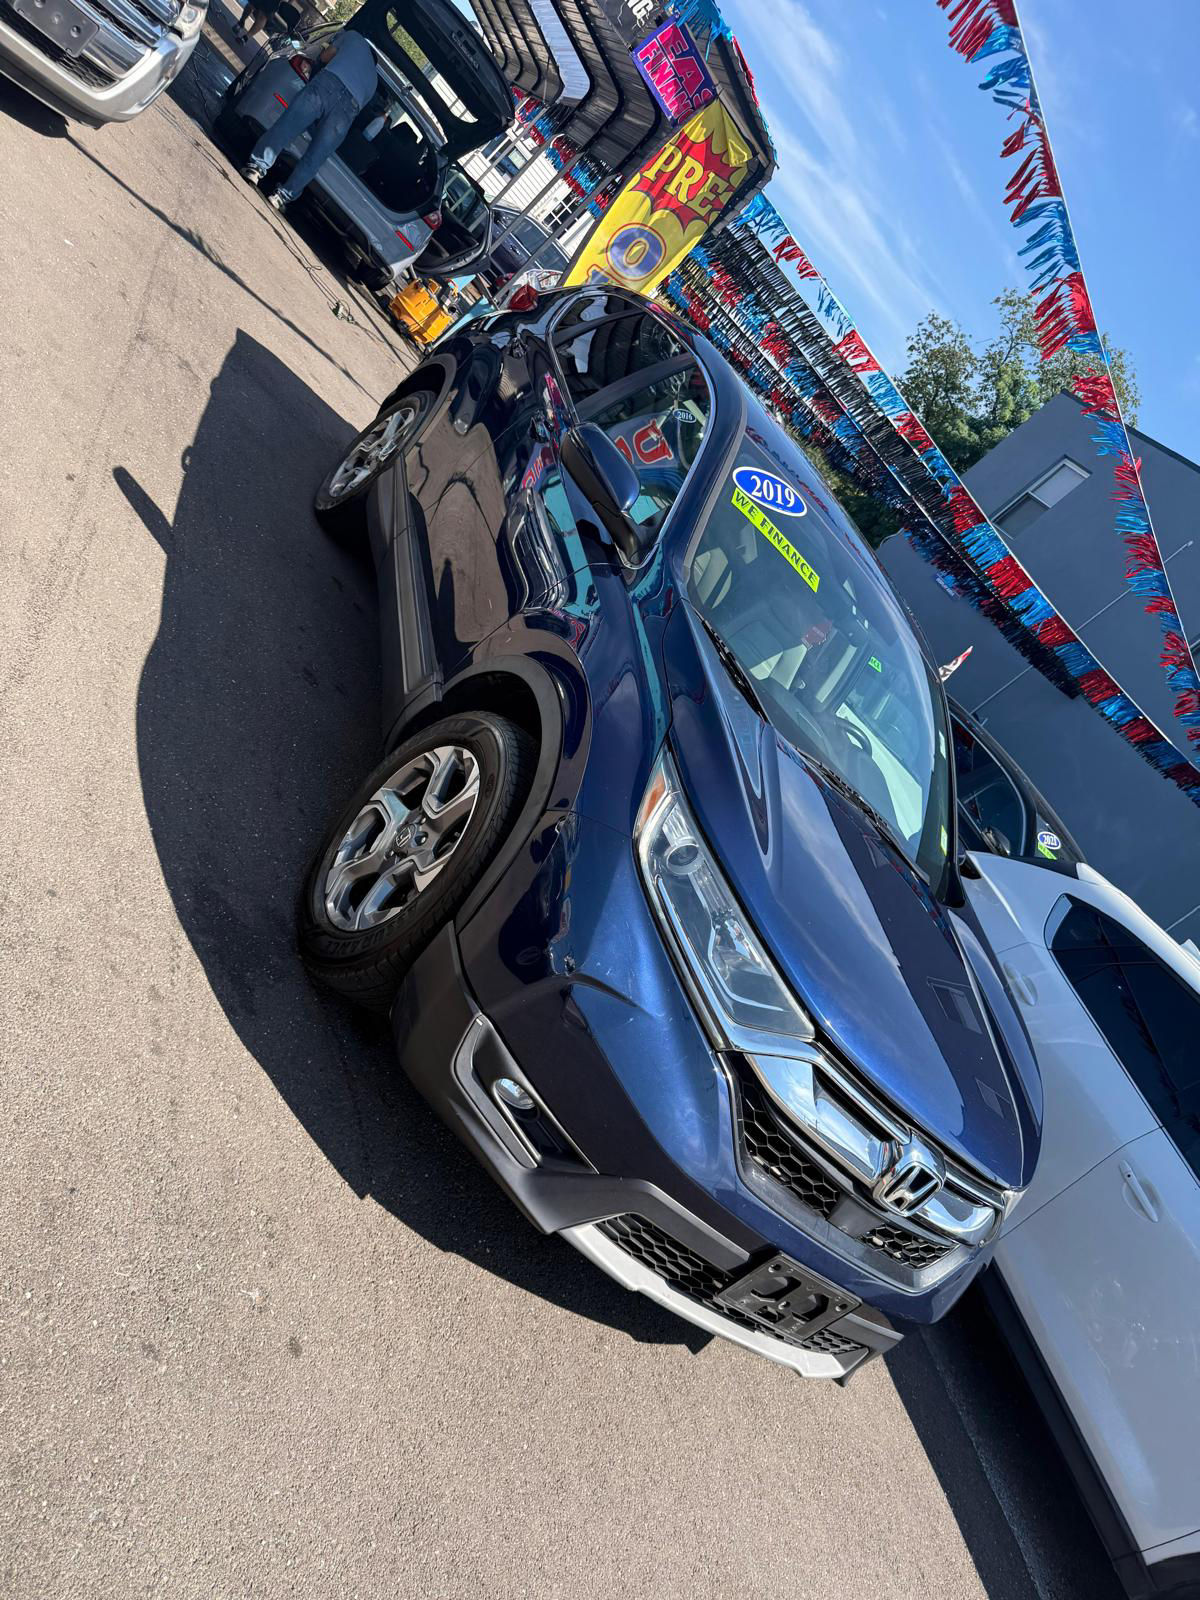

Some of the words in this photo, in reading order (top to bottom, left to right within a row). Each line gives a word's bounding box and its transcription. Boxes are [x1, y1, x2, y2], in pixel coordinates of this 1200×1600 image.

[638, 38, 694, 122] FINAN
[643, 141, 731, 219] PRE
[750, 475, 796, 508] 2019
[735, 495, 757, 520] WE
[760, 519, 818, 584] FINANCE
